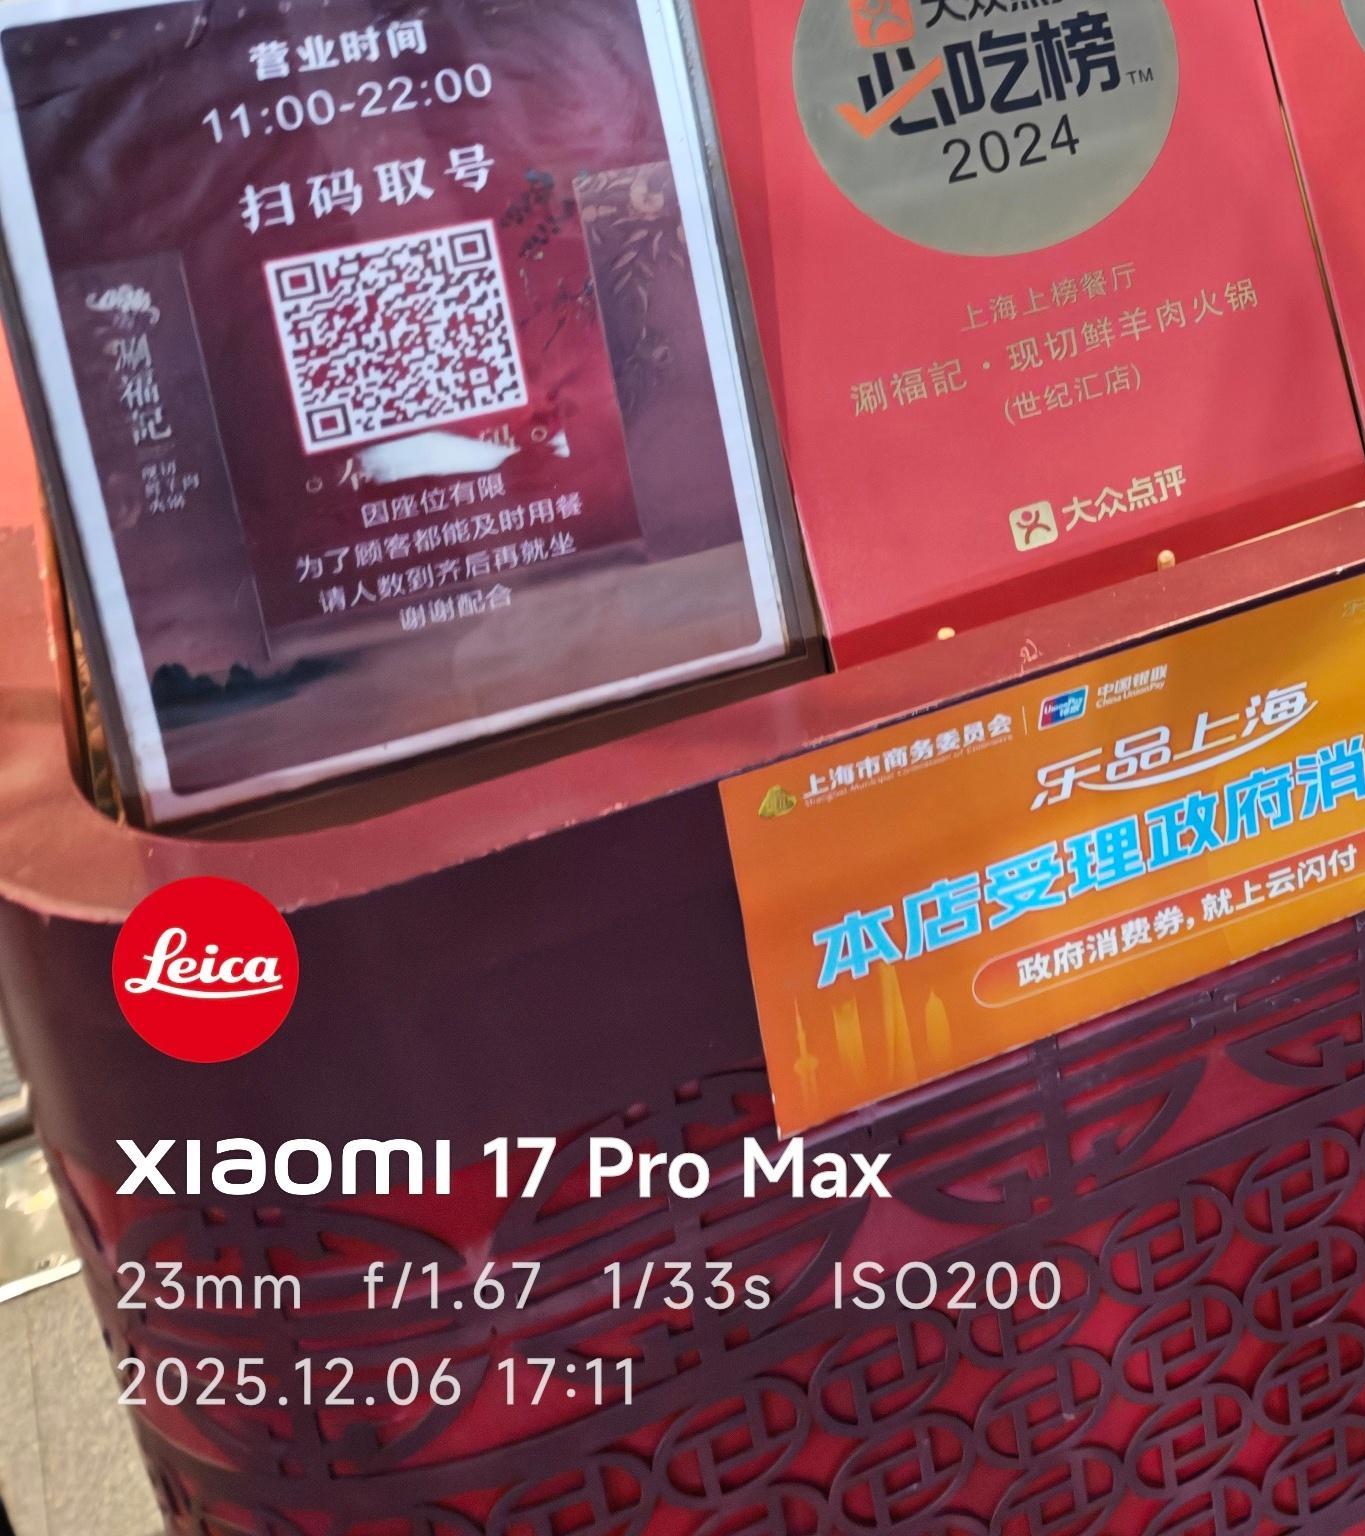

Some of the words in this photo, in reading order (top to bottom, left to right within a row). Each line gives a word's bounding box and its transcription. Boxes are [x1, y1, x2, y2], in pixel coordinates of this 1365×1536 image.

[248, 19, 429, 82] 营业时间
[837, 9, 1121, 141] 必吃榜
[201, 62, 494, 146] 11:00-22:00
[941, 112, 1081, 186] 2024
[238, 145, 497, 235] 扫码取号
[960, 262, 1137, 333] 上海上榜餐厅
[1002, 364, 1142, 425] (世纪汇店)
[360, 473, 506, 528] 因座位有限
[1062, 465, 1187, 533] 大众点评
[296, 492, 582, 583] 为了顾客都能及时用餐
[319, 532, 576, 614] 请人数到齐后再就坐
[399, 582, 512, 631] 谢谢配合
[802, 713, 1013, 800] 上海市商务委员会
[1097, 664, 1168, 698] 中国银联
[1096, 692, 1122, 709] China
[1030, 681, 1309, 810] 乐品上海
